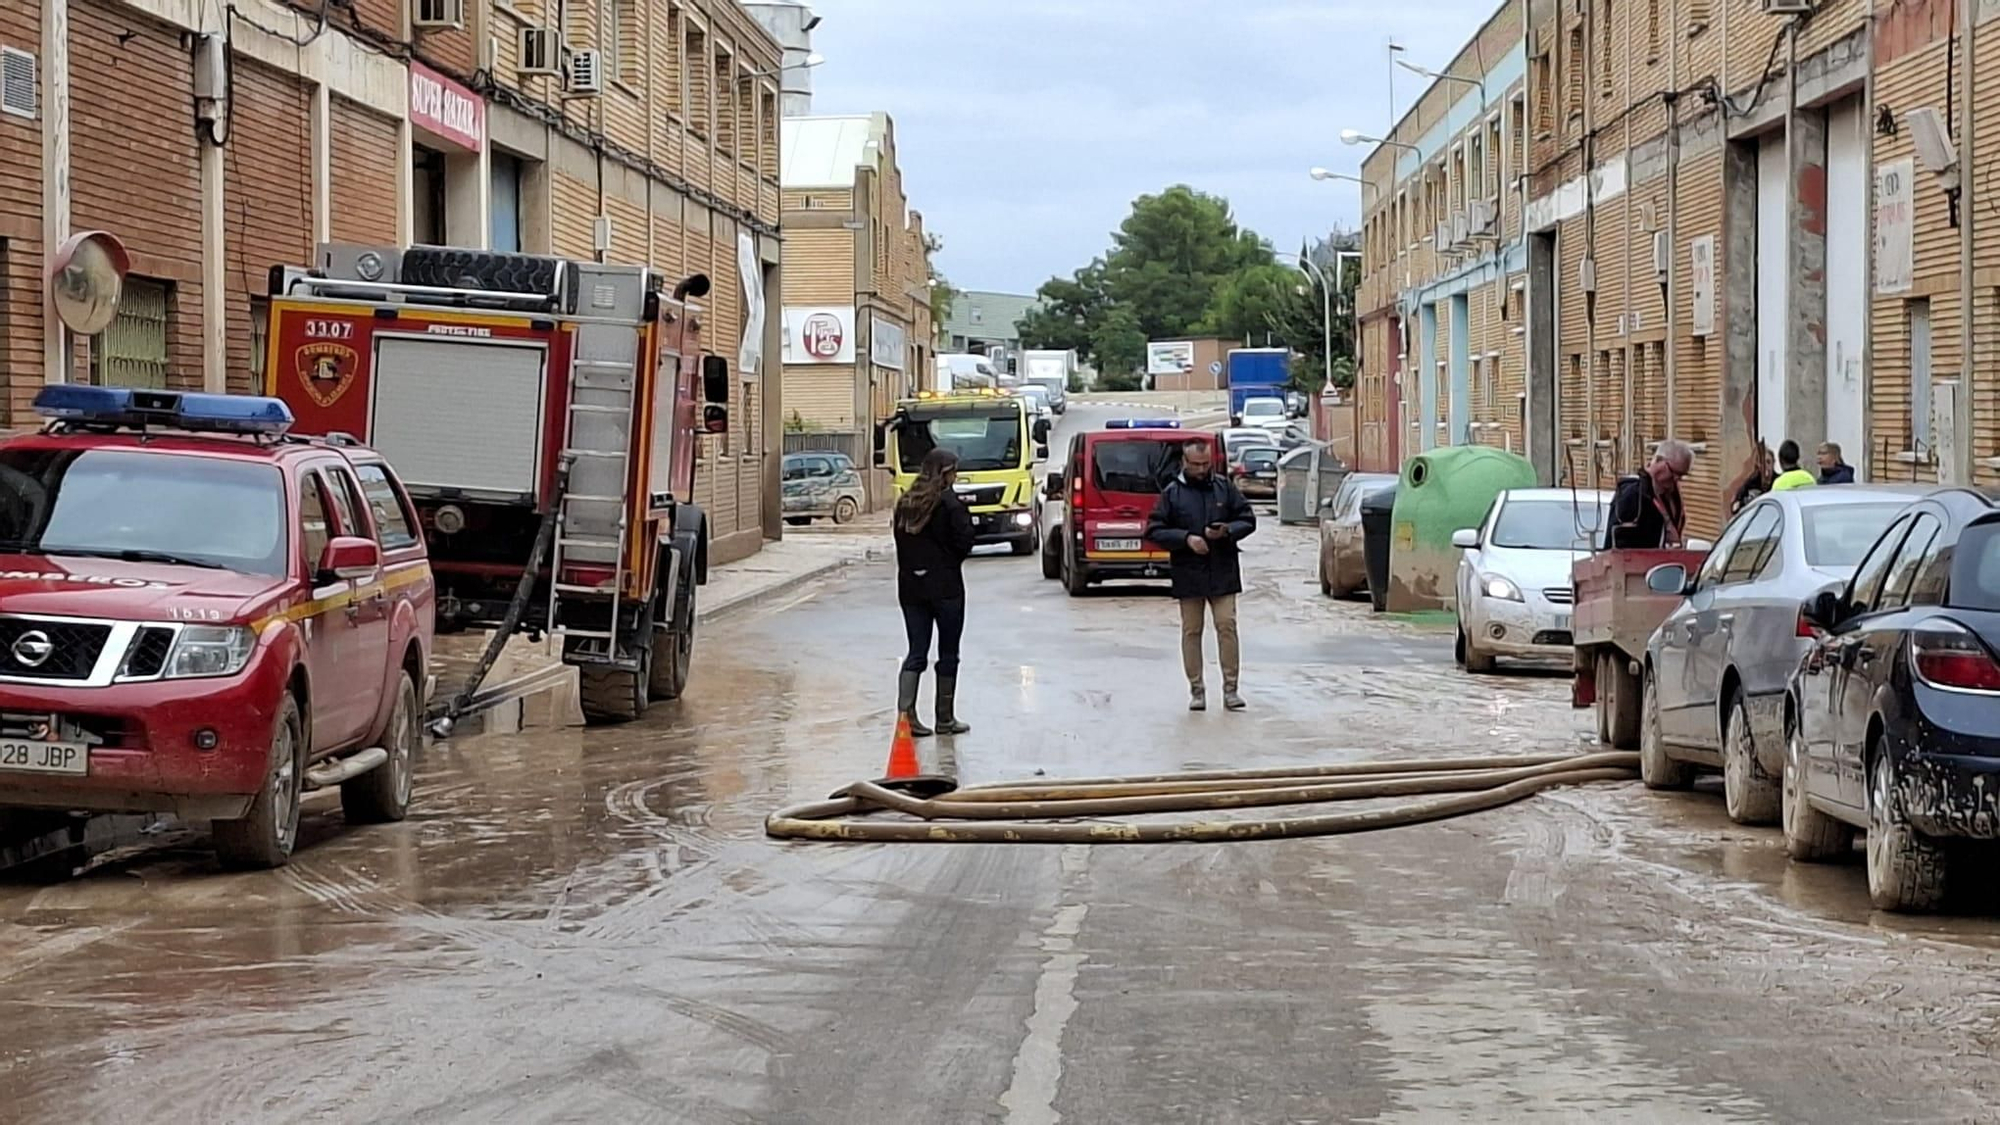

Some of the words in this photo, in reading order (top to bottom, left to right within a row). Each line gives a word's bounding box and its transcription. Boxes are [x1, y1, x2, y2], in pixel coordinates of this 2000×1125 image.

[412, 72, 442, 123] SUPER
[306, 320, 353, 338] 3307
[0, 571, 168, 590] MBEROS
[0, 744, 28, 765] 28
[37, 746, 76, 768] JBP
